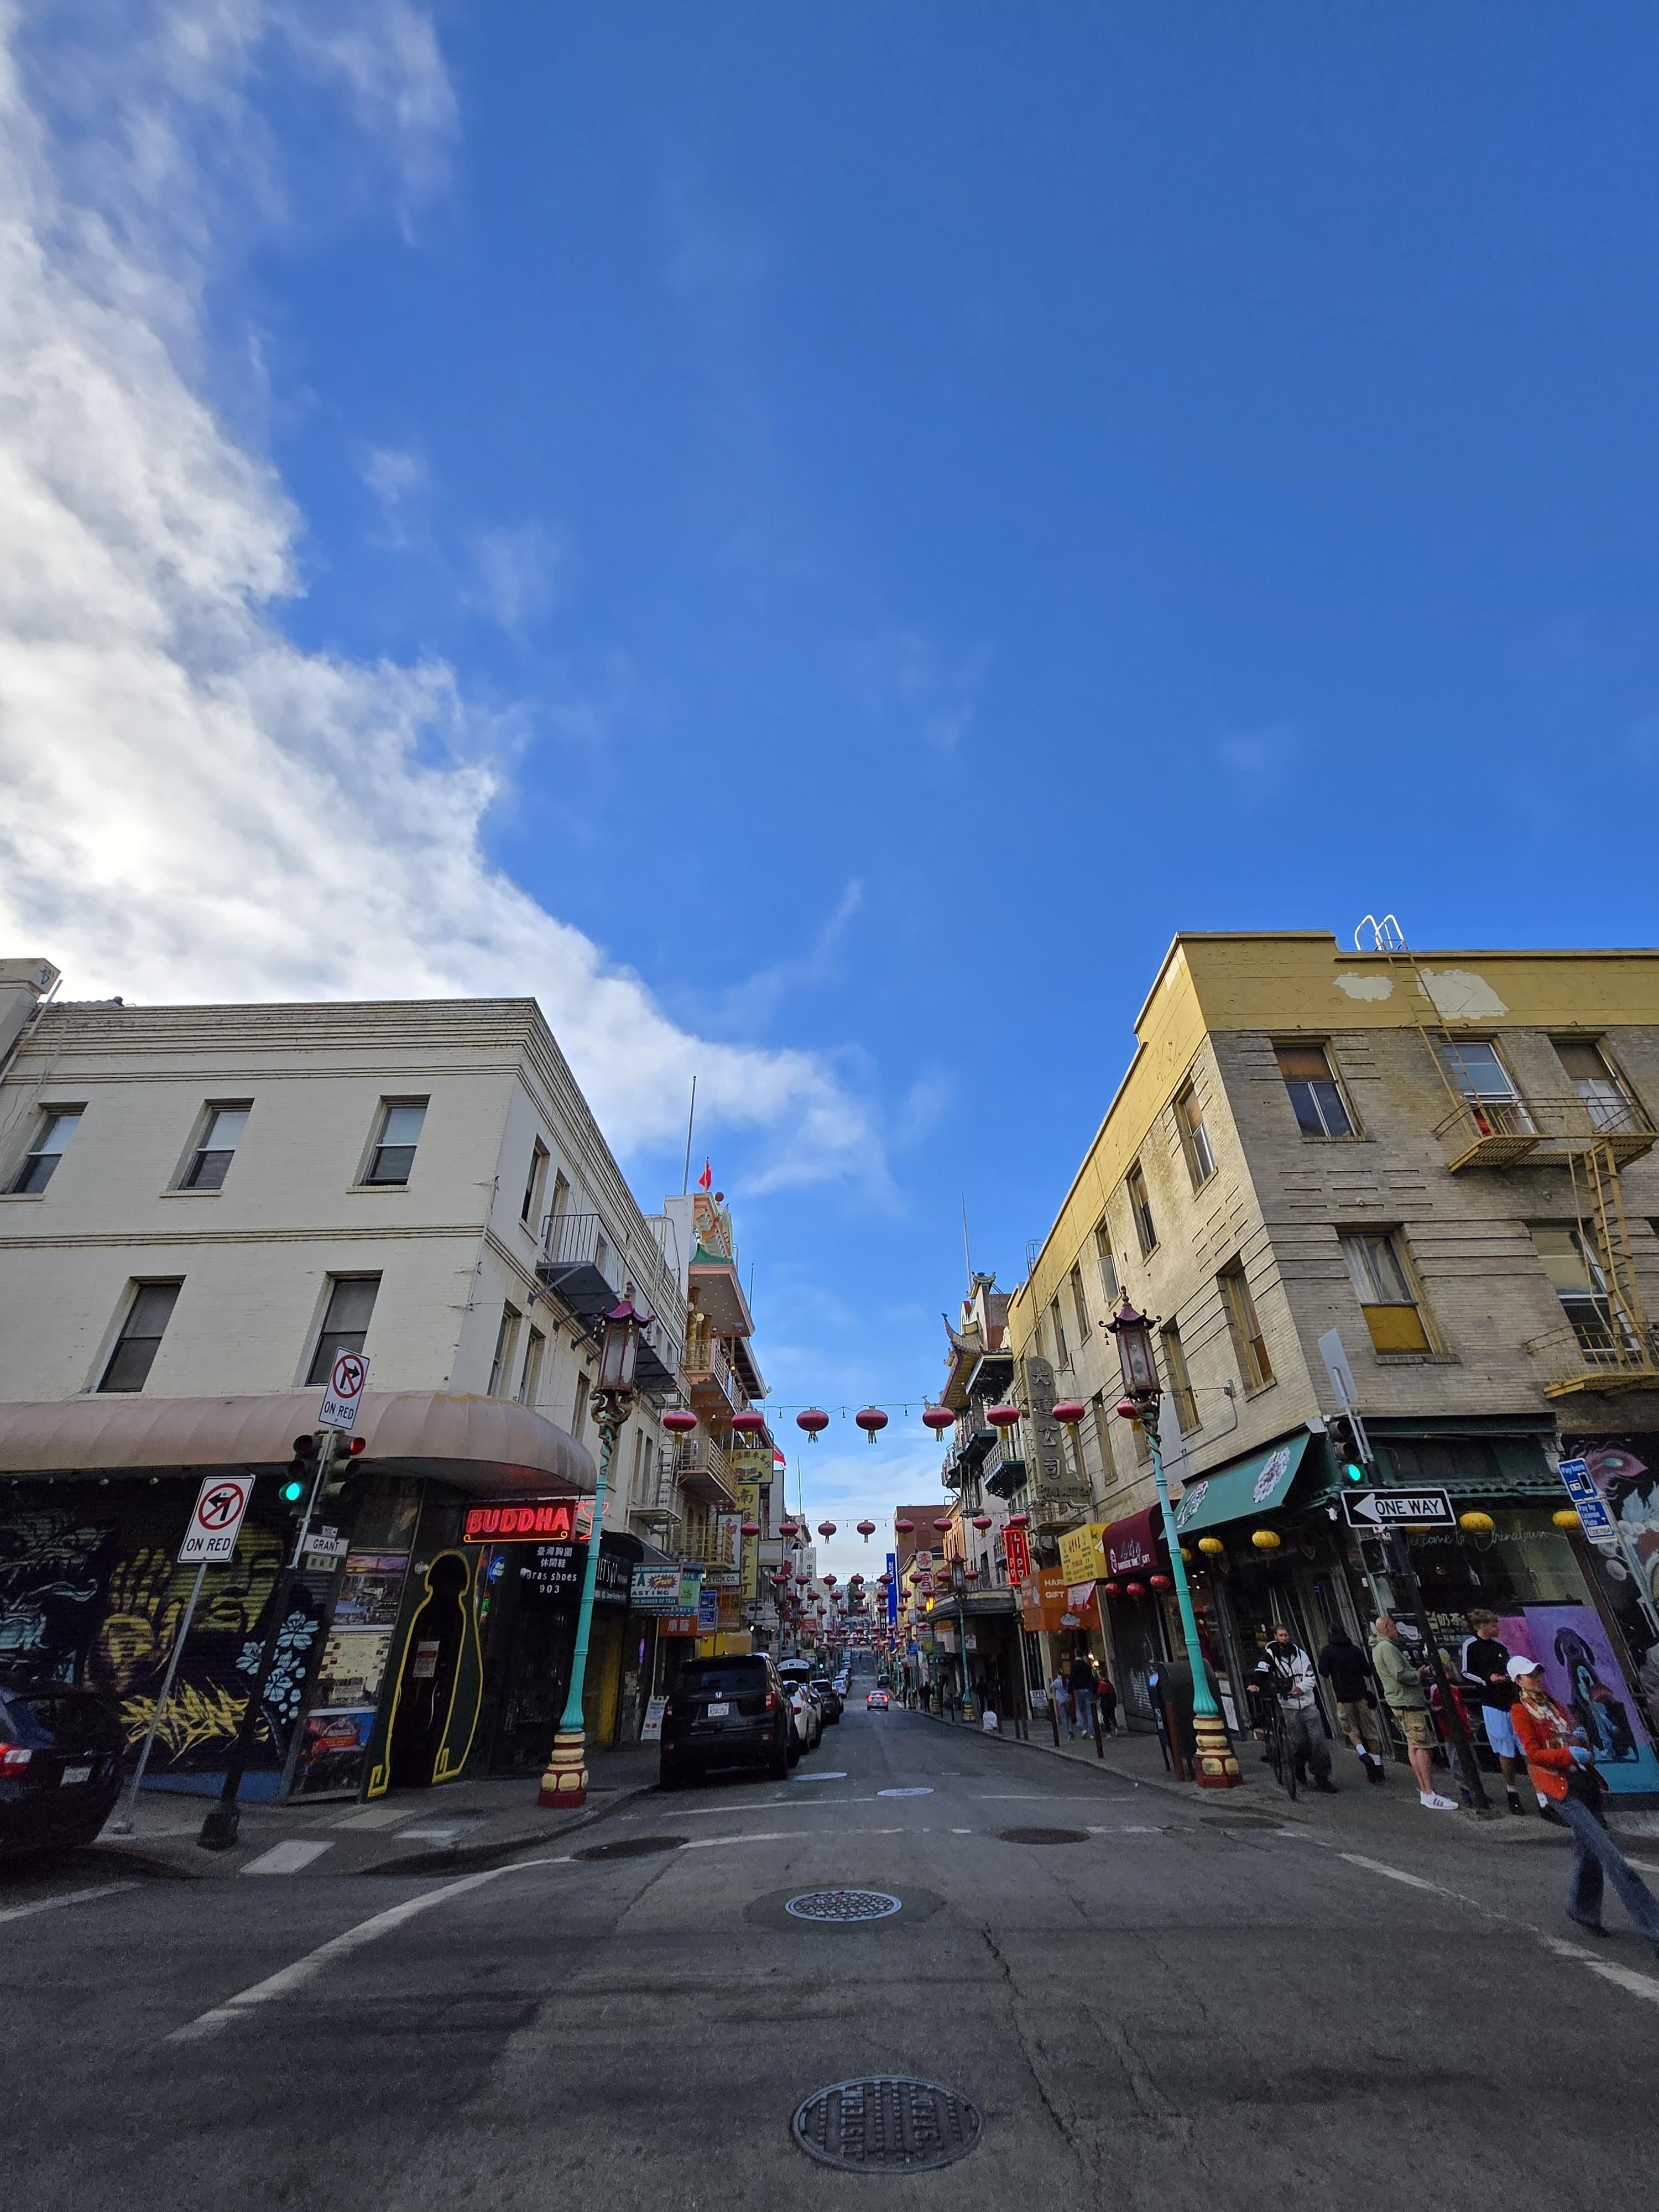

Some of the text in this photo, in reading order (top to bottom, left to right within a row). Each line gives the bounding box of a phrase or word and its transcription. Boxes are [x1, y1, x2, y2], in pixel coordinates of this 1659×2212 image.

[324, 1401, 354, 1420] ON RED
[1561, 1463, 1586, 1475] Pay here
[1375, 1500, 1439, 1515] ONE WAY
[466, 1507, 570, 1533] BUDDHA
[186, 1538, 231, 1552] ON RED
[313, 1538, 340, 1552] GRANT
[550, 1572, 577, 1582] shoes
[654, 1577, 672, 1587] Free
[539, 1584, 560, 1594] 903
